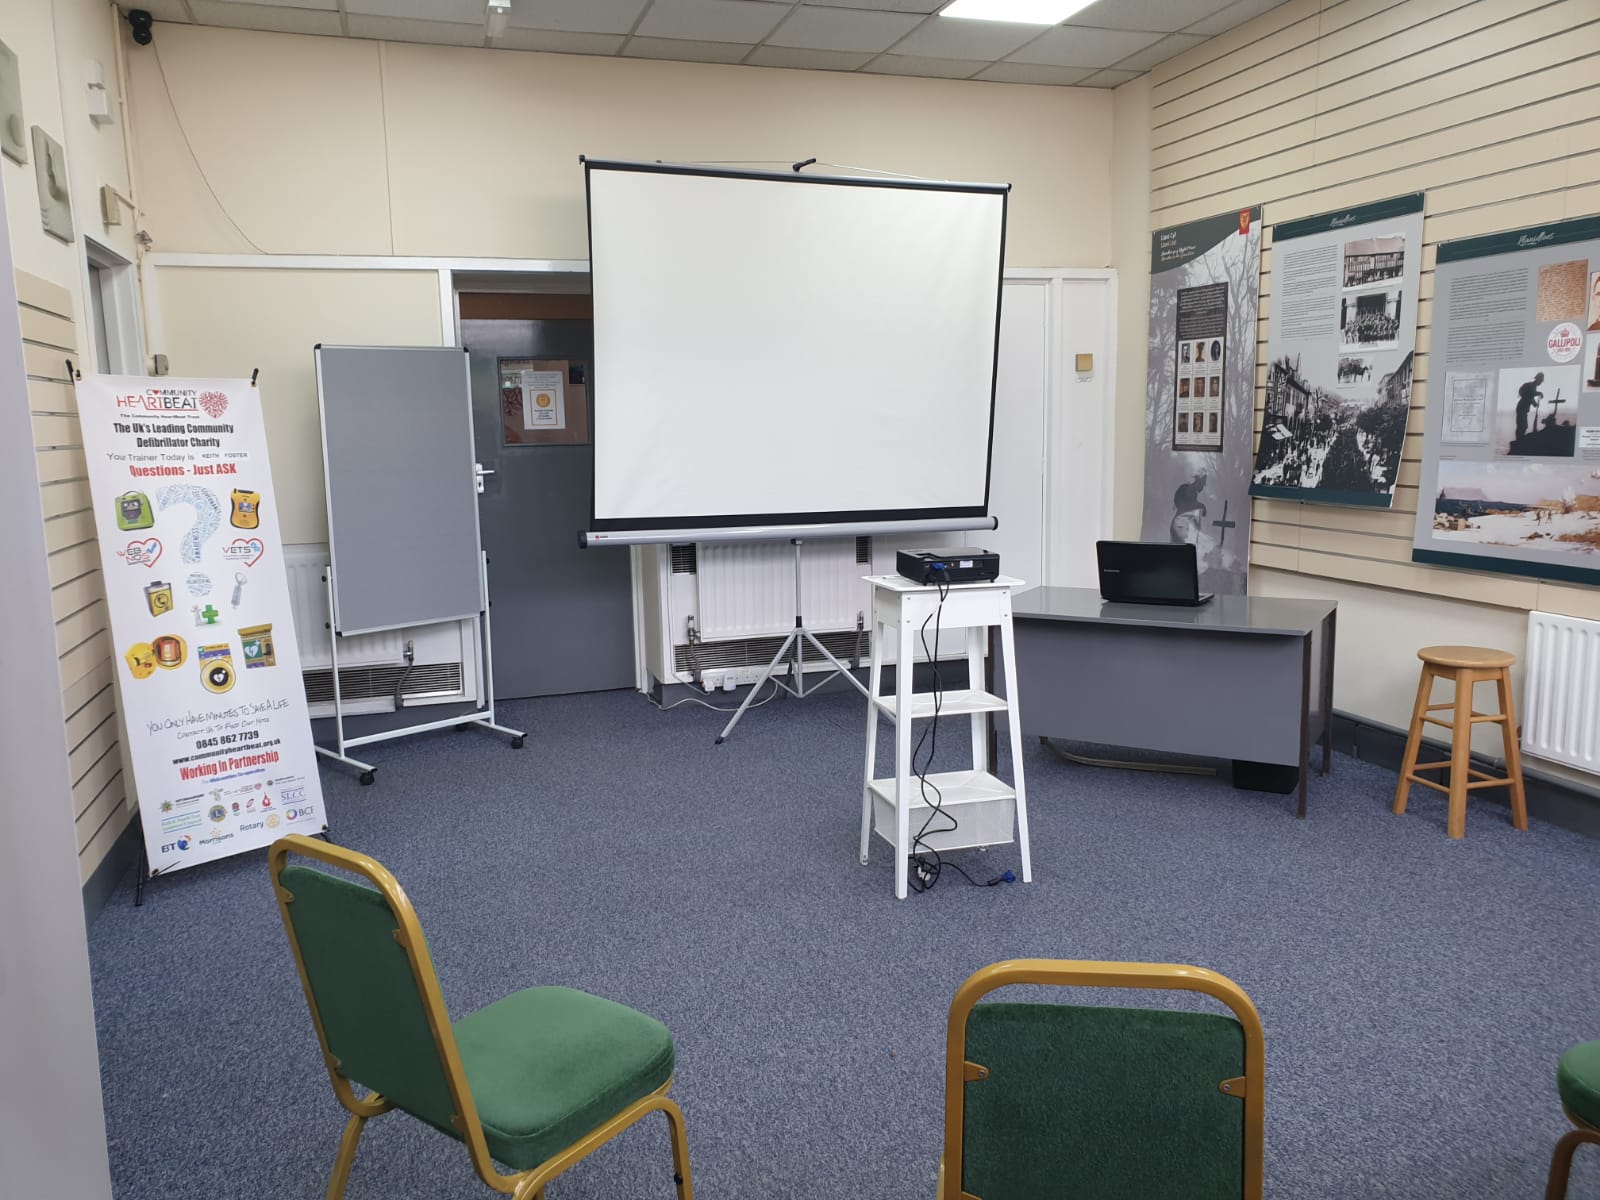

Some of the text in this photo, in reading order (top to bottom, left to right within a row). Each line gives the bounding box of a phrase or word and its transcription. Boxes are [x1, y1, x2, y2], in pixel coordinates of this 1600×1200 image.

[1549, 338, 1581, 348] GALLIPOLI
[116, 395, 197, 410] HEARTBEAT
[114, 423, 130, 433] The
[153, 423, 185, 434] Leading
[187, 423, 234, 434] Community
[137, 437, 221, 448] Defibrillator Charity
[128, 454, 157, 462] Trainer
[160, 453, 186, 462] Today
[129, 465, 185, 477] Questions
[193, 464, 214, 475] Just
[216, 463, 237, 474] ASK
[222, 546, 251, 554] VETS
[164, 717, 185, 730] ONLY
[186, 710, 206, 725] HAVE
[206, 709, 239, 722] MINUTES
[196, 730, 260, 750] 0845 862 7739
[180, 761, 218, 780] Working
[219, 759, 228, 771] In
[229, 750, 279, 770] Partnership
[239, 820, 264, 832] Rotary
[199, 833, 234, 846] Morrisons
[161, 843, 176, 853] BT
